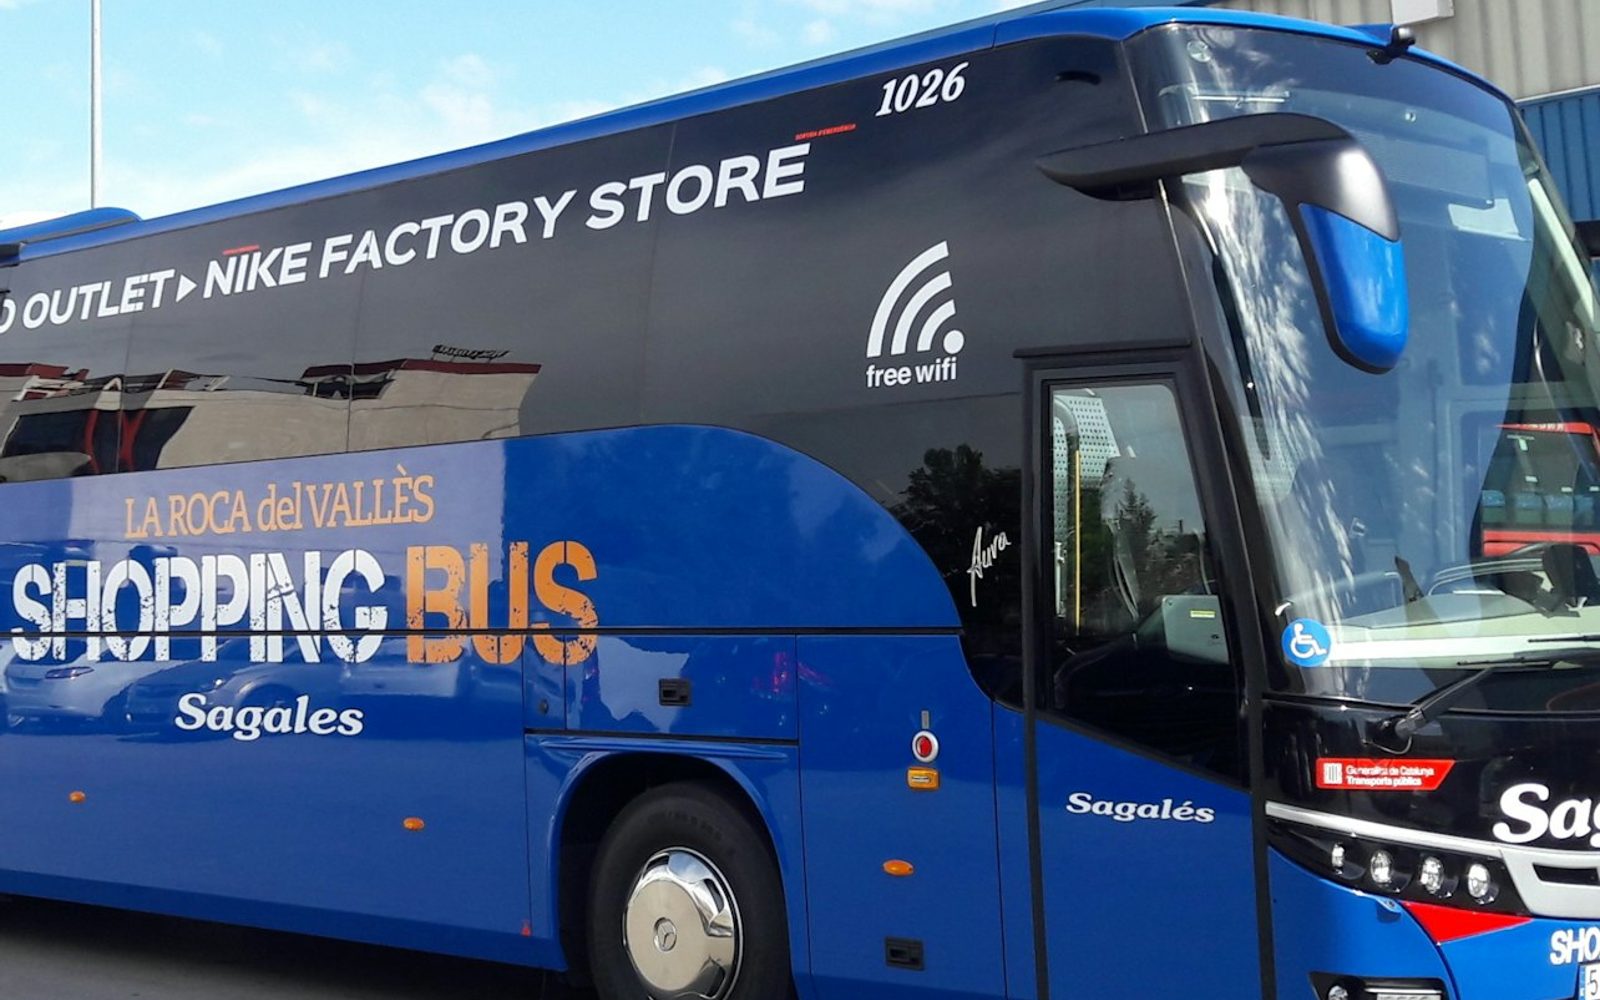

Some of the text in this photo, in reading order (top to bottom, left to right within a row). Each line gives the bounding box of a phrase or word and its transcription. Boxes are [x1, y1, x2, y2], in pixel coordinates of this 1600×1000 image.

[874, 61, 970, 117] 1026
[22, 268, 176, 329] OUTLET
[202, 241, 313, 299] NIKE
[318, 189, 578, 280] FACTORY
[585, 142, 811, 231] STORE
[866, 356, 958, 389] free wifi
[124, 464, 436, 540] LA ROCA del VALLÈS
[966, 525, 1012, 608] Aura
[10, 540, 601, 666] SHOPPING BUS
[174, 693, 365, 742] Sagales
[1388, 766, 1399, 776] de
[1065, 792, 1216, 824] Sagalés
